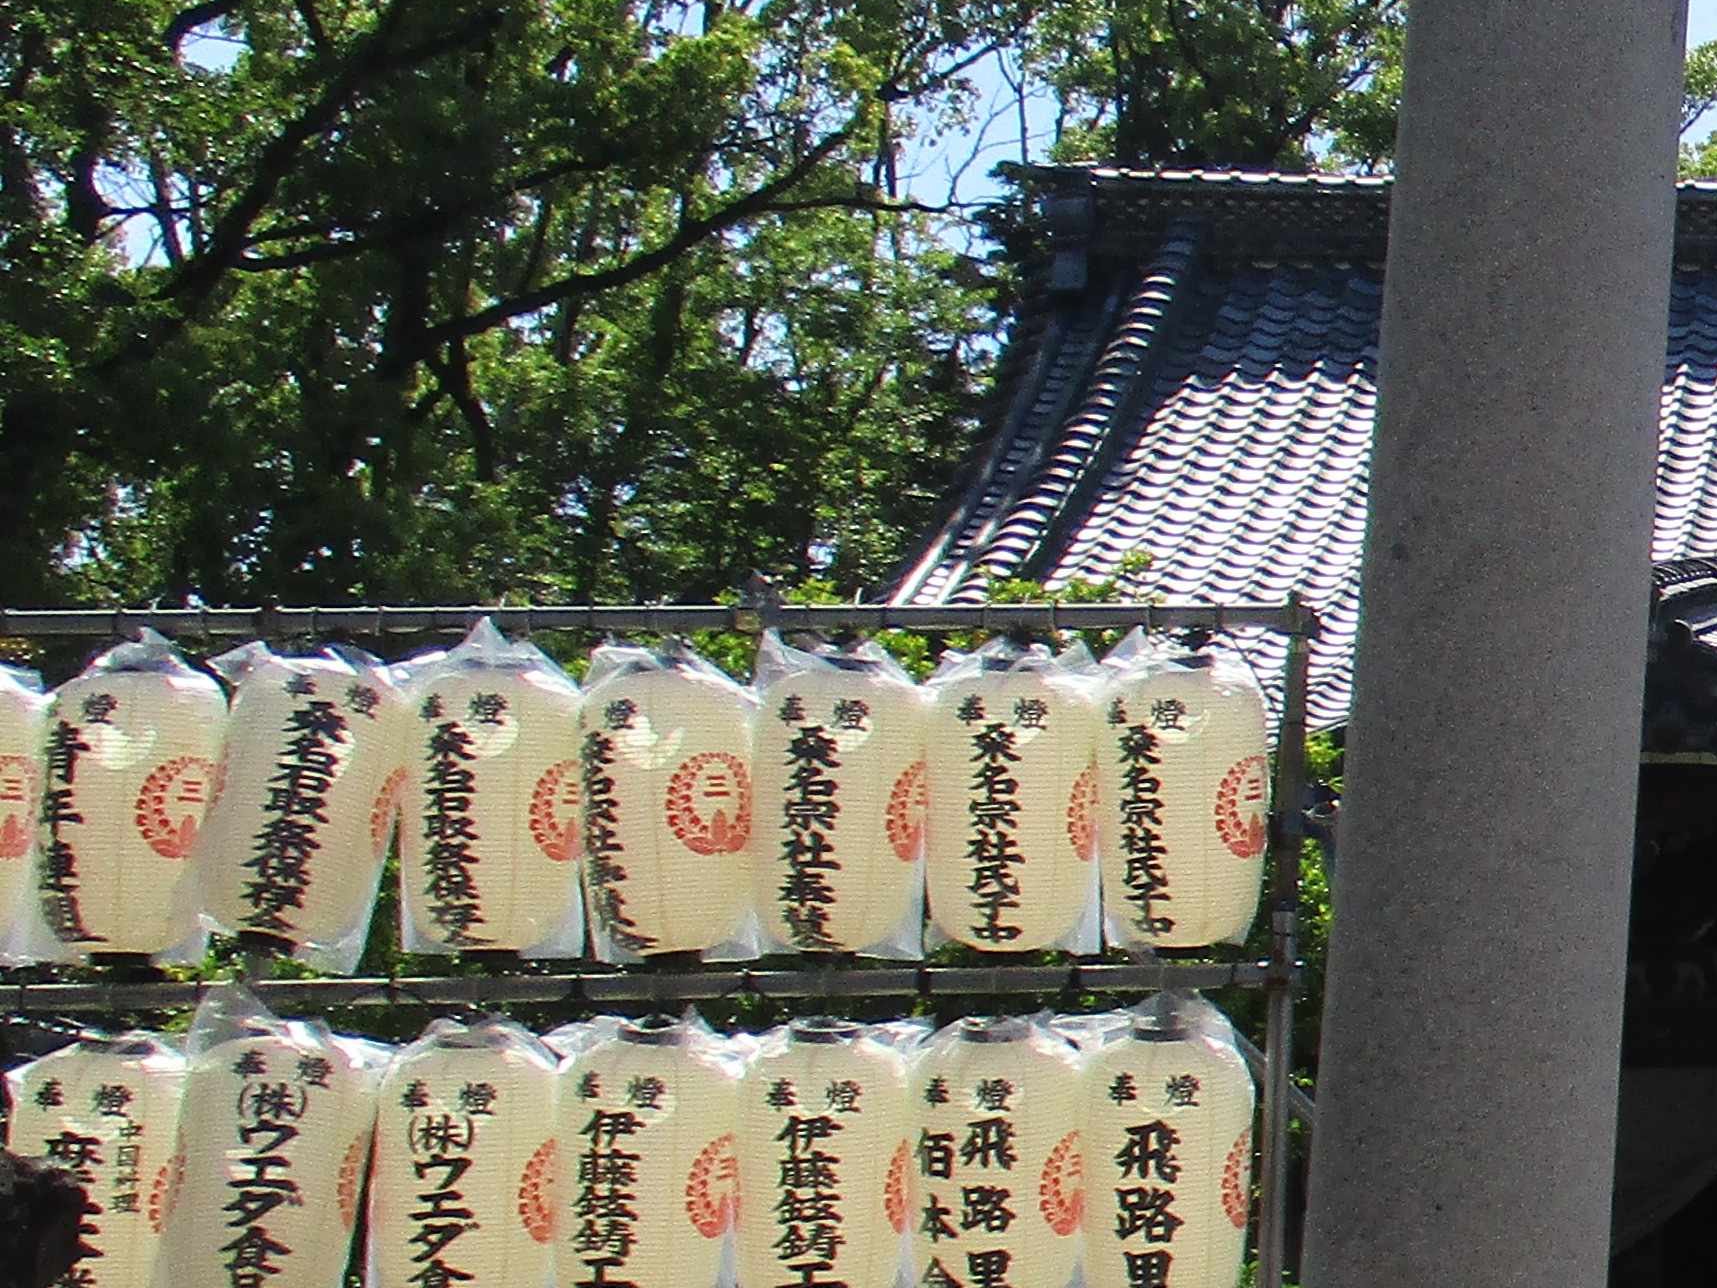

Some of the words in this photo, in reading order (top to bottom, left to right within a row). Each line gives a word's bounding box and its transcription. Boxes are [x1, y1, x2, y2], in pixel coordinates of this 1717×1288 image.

[963, 722, 1026, 944] 桑名宗社氏子中
[1118, 724, 1177, 938] 桑名宗社氏子中
